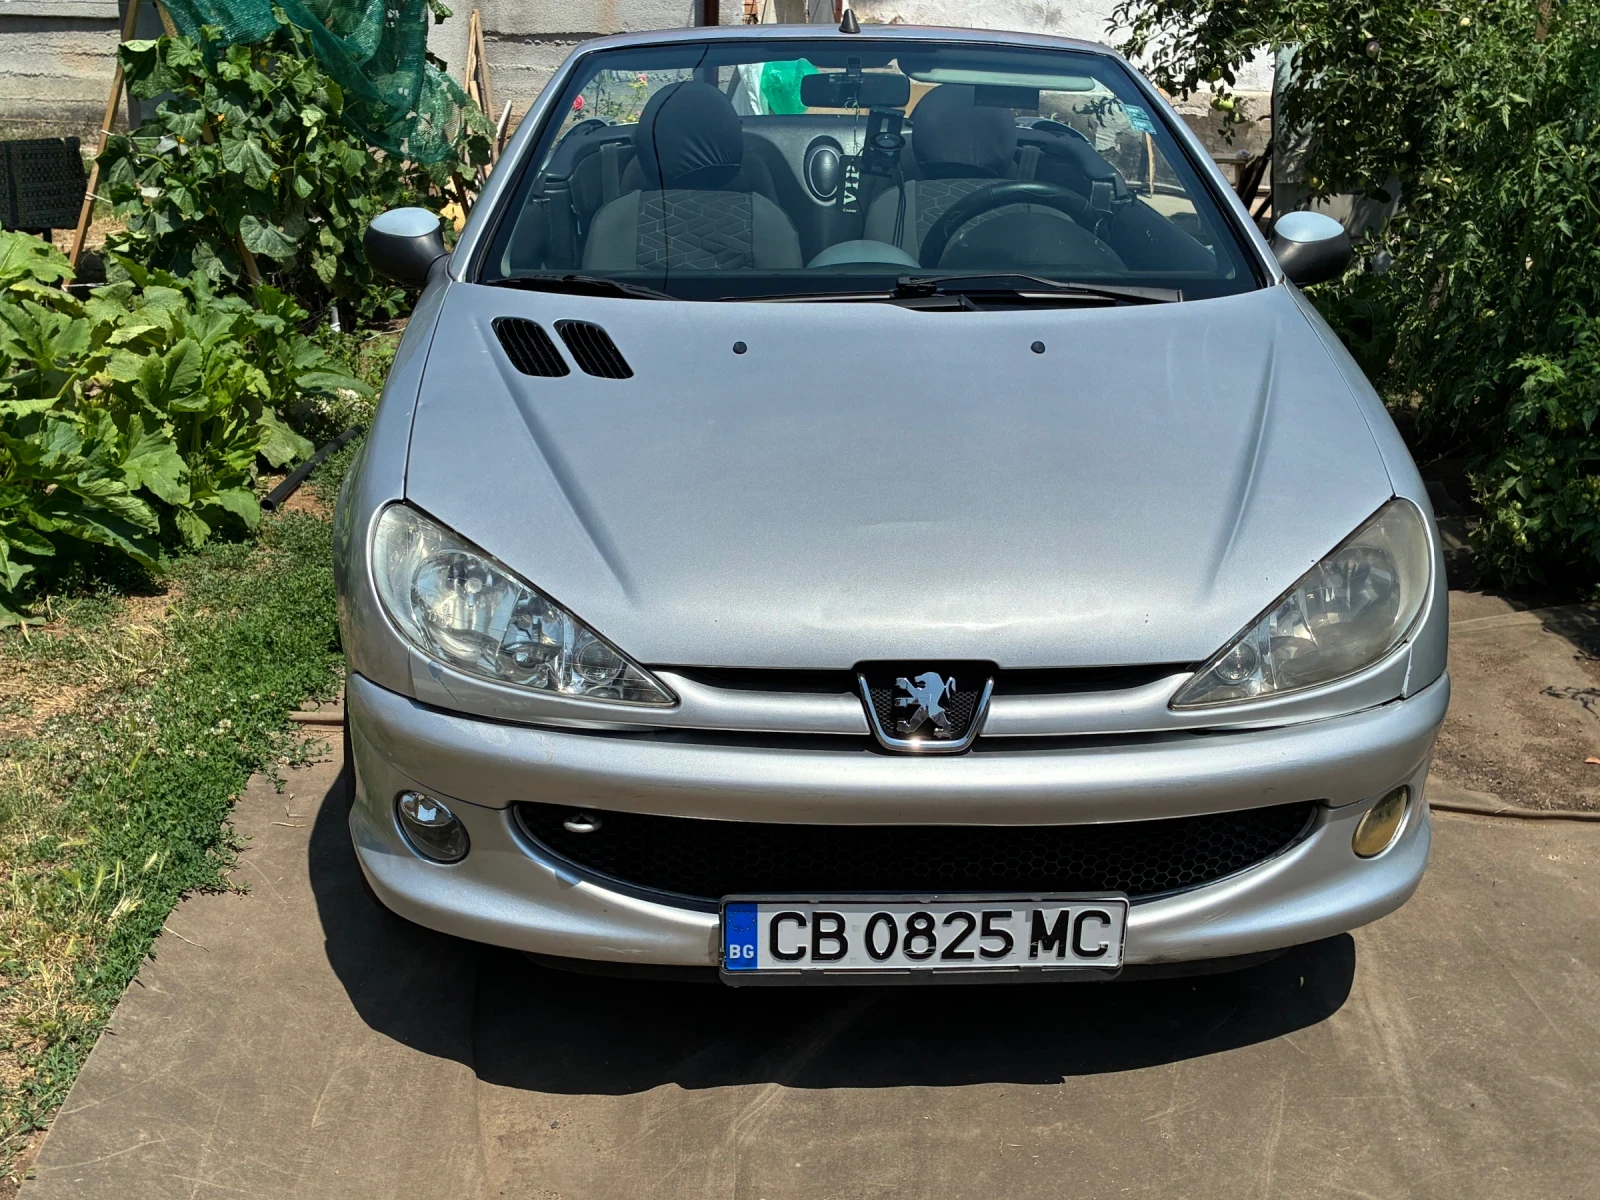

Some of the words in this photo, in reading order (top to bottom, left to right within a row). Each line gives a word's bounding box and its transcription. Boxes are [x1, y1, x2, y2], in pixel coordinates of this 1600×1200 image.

[843, 165, 860, 205] VIP
[729, 944, 755, 959] BG
[769, 911, 848, 961] CB
[864, 910, 1014, 961] 0825
[1028, 909, 1111, 958] MC
